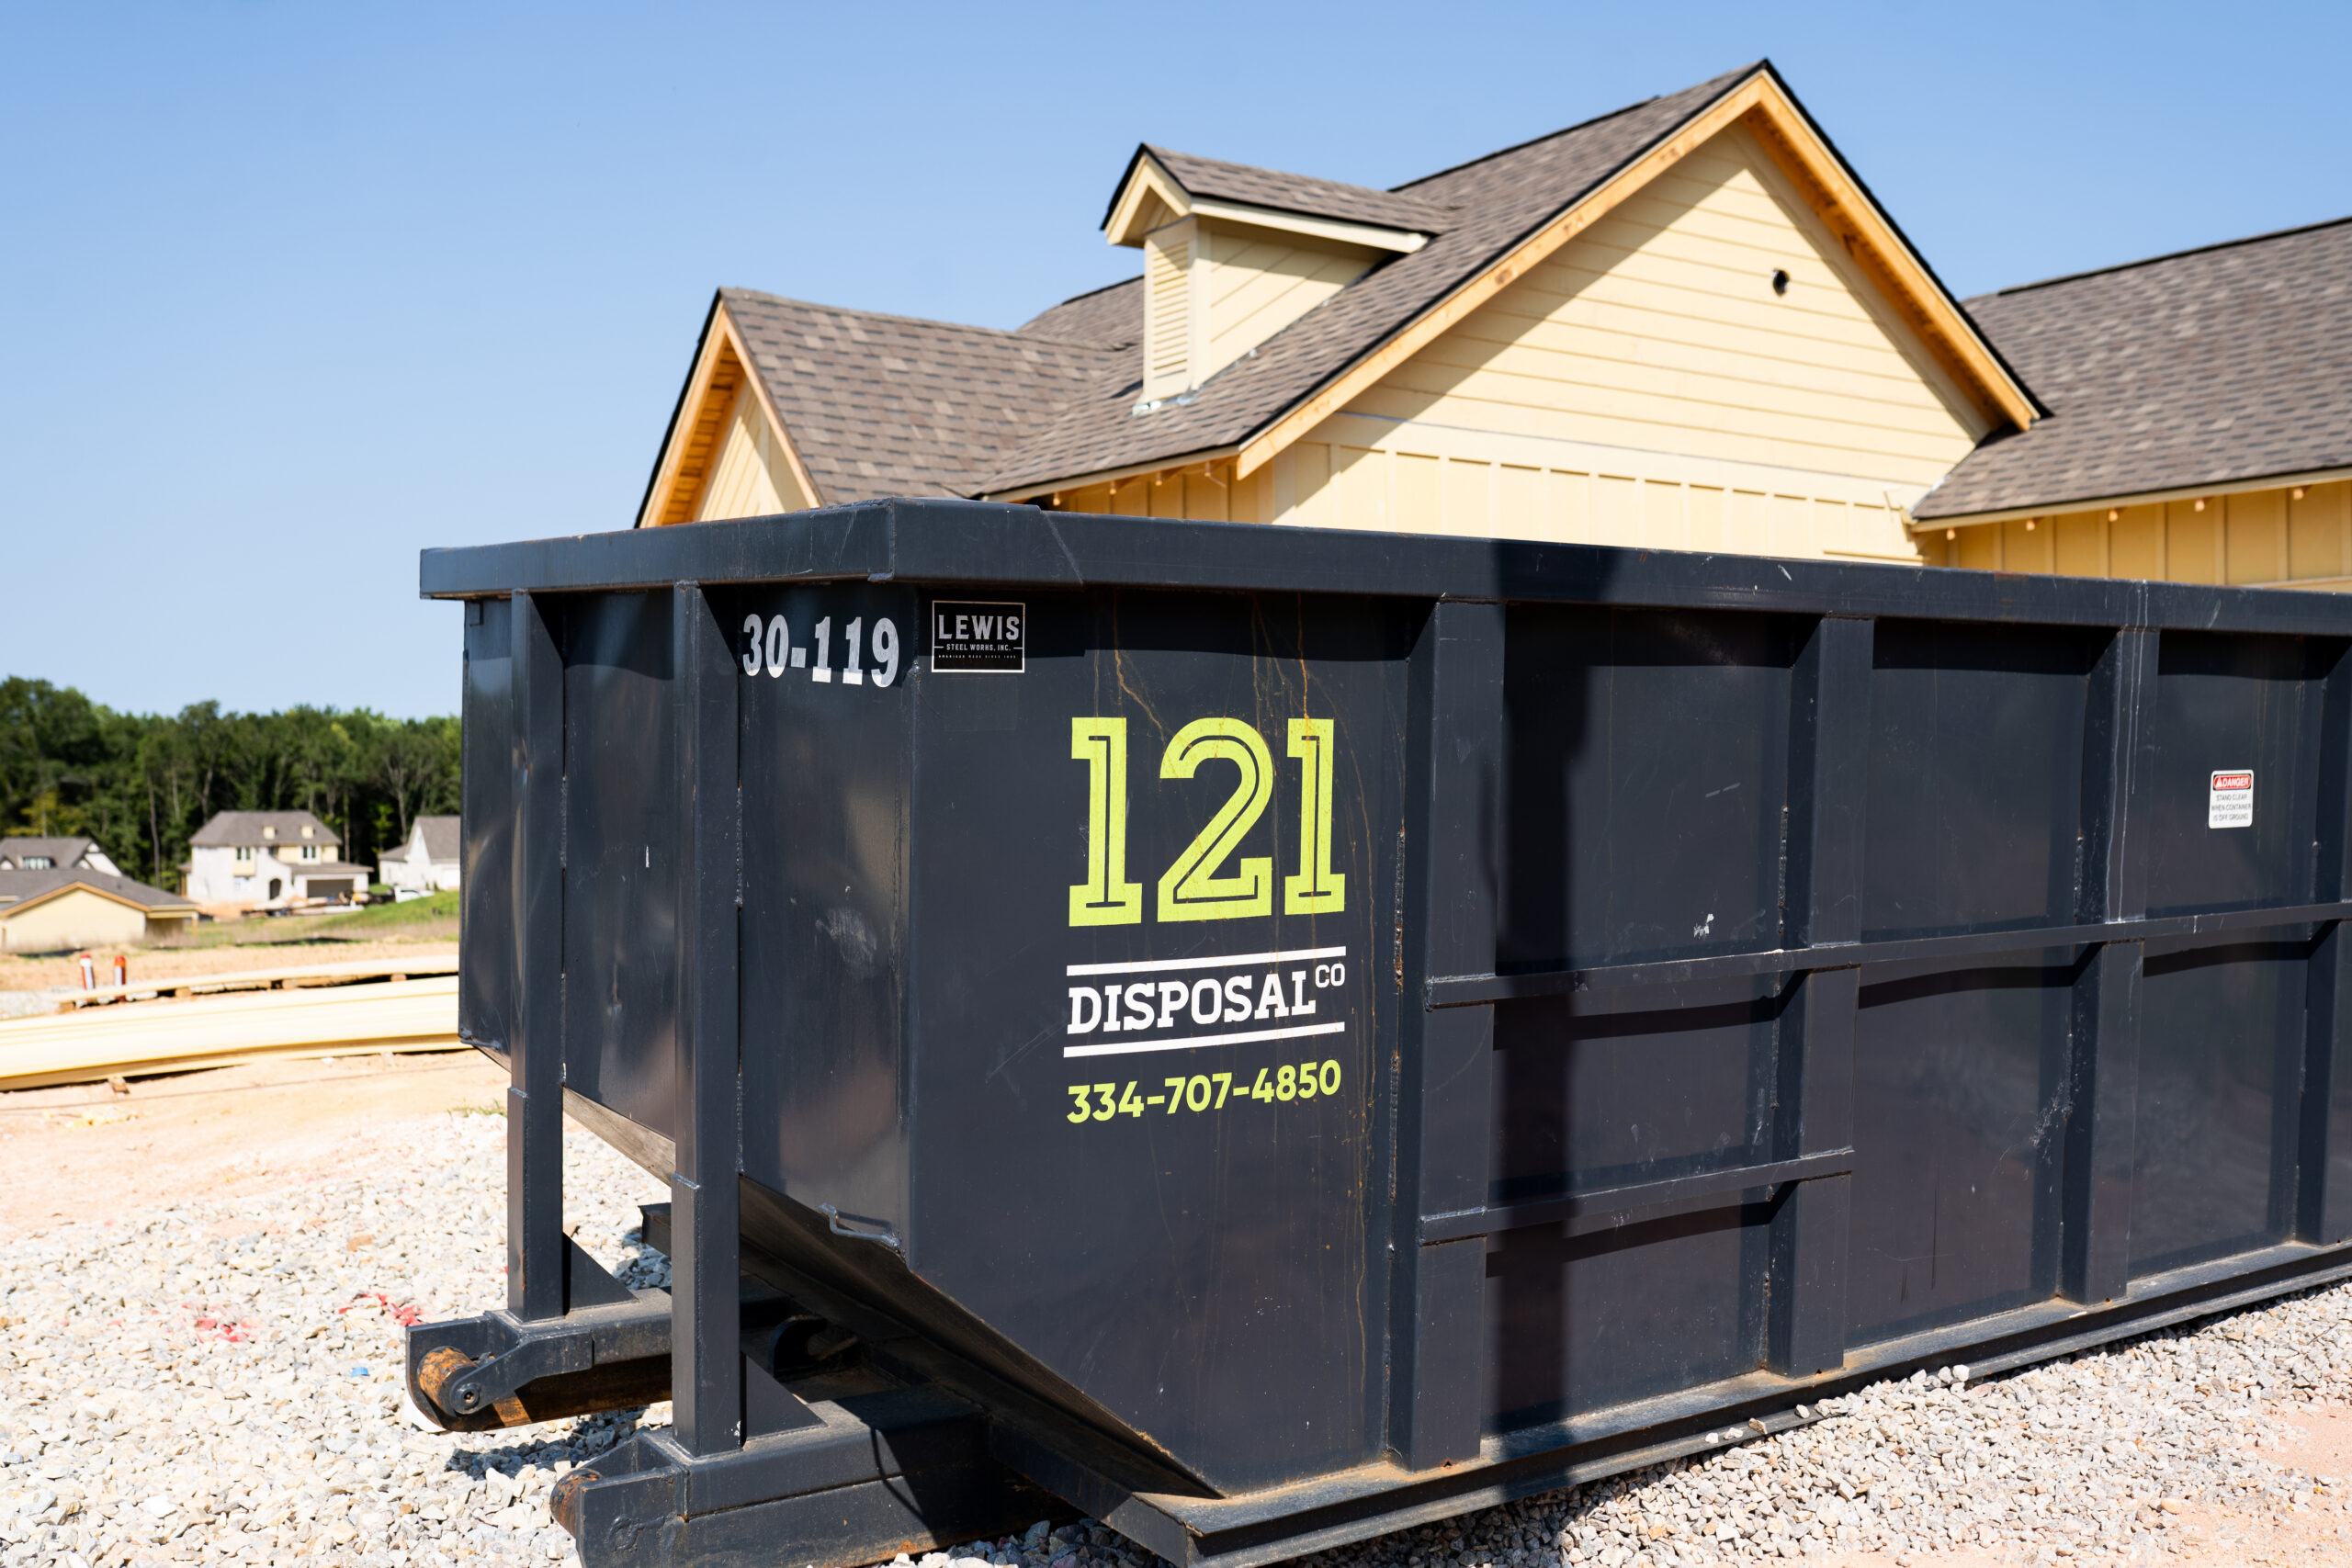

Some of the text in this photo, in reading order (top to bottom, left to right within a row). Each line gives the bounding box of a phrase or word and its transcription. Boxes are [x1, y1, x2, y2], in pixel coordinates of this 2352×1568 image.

[742, 614, 899, 688] 30-119
[938, 615, 1020, 640] LEWIS
[2222, 777, 2249, 787] DANGER
[1069, 716, 1345, 927] 121
[1067, 963, 1345, 1035] DISPOSAL CO
[1066, 1059, 1341, 1124] 334-707-4850
